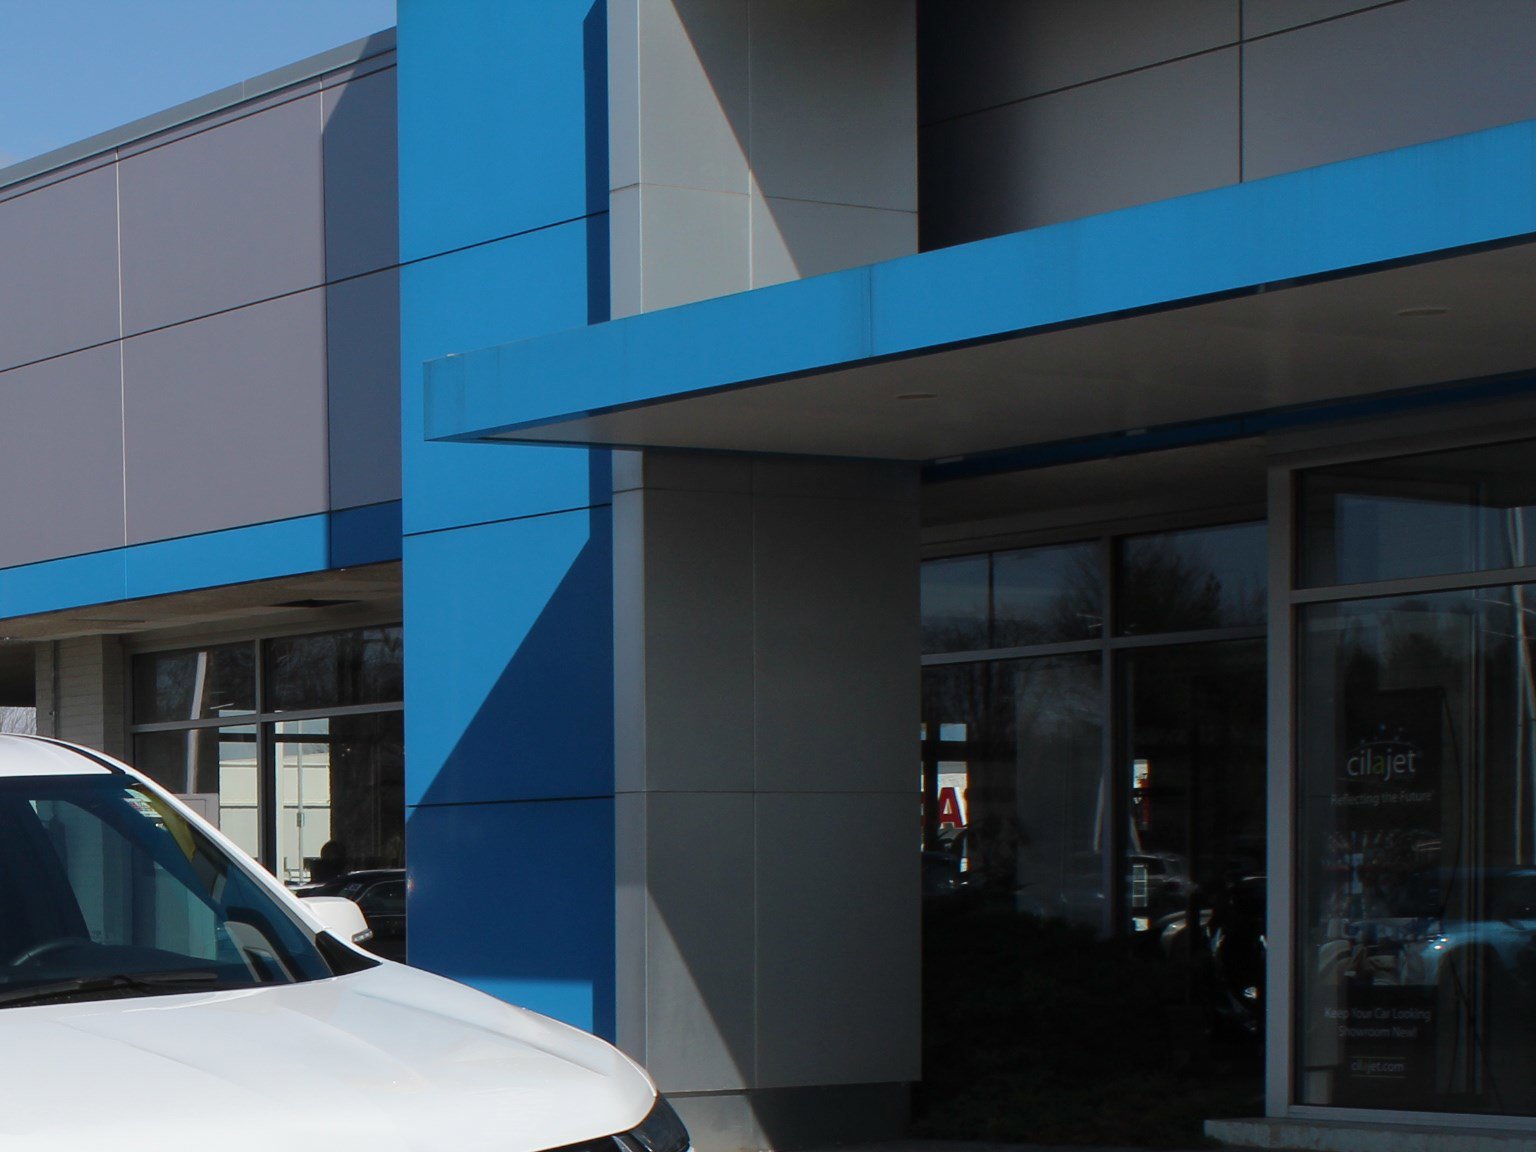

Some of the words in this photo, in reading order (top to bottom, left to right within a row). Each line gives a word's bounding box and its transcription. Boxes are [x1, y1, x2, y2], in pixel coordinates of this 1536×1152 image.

[1347, 748, 1416, 781] cilajet
[1331, 792, 1378, 806] Reflecting
[1351, 1008, 1372, 1019] Your
[1375, 1008, 1390, 1019] Car
[1392, 1008, 1432, 1023] Looking
